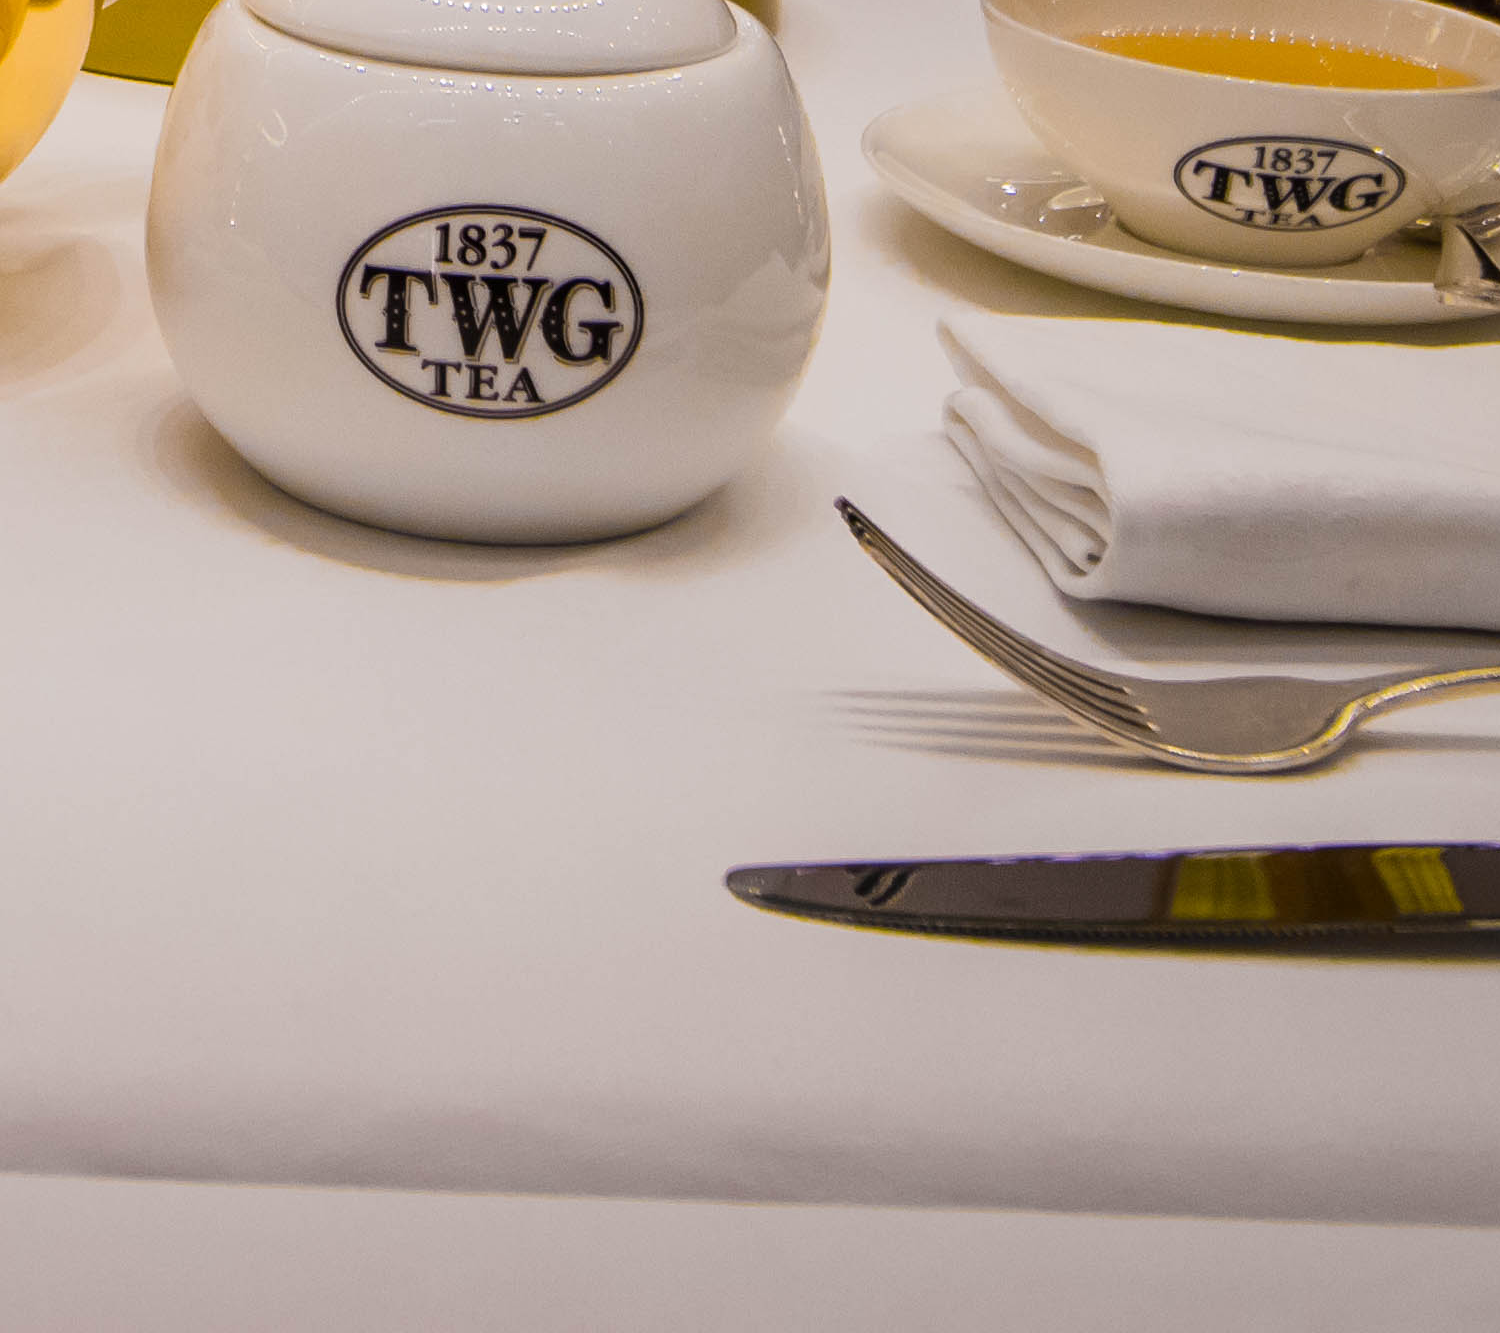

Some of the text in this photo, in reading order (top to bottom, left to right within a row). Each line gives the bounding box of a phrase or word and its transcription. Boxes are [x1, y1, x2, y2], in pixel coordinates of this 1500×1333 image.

[1252, 145, 1339, 175] 1837
[1192, 159, 1388, 214] TWG
[1234, 207, 1323, 227] TEA
[434, 221, 548, 272] 1837
[358, 262, 624, 366] TWG
[420, 358, 547, 404] TEA
